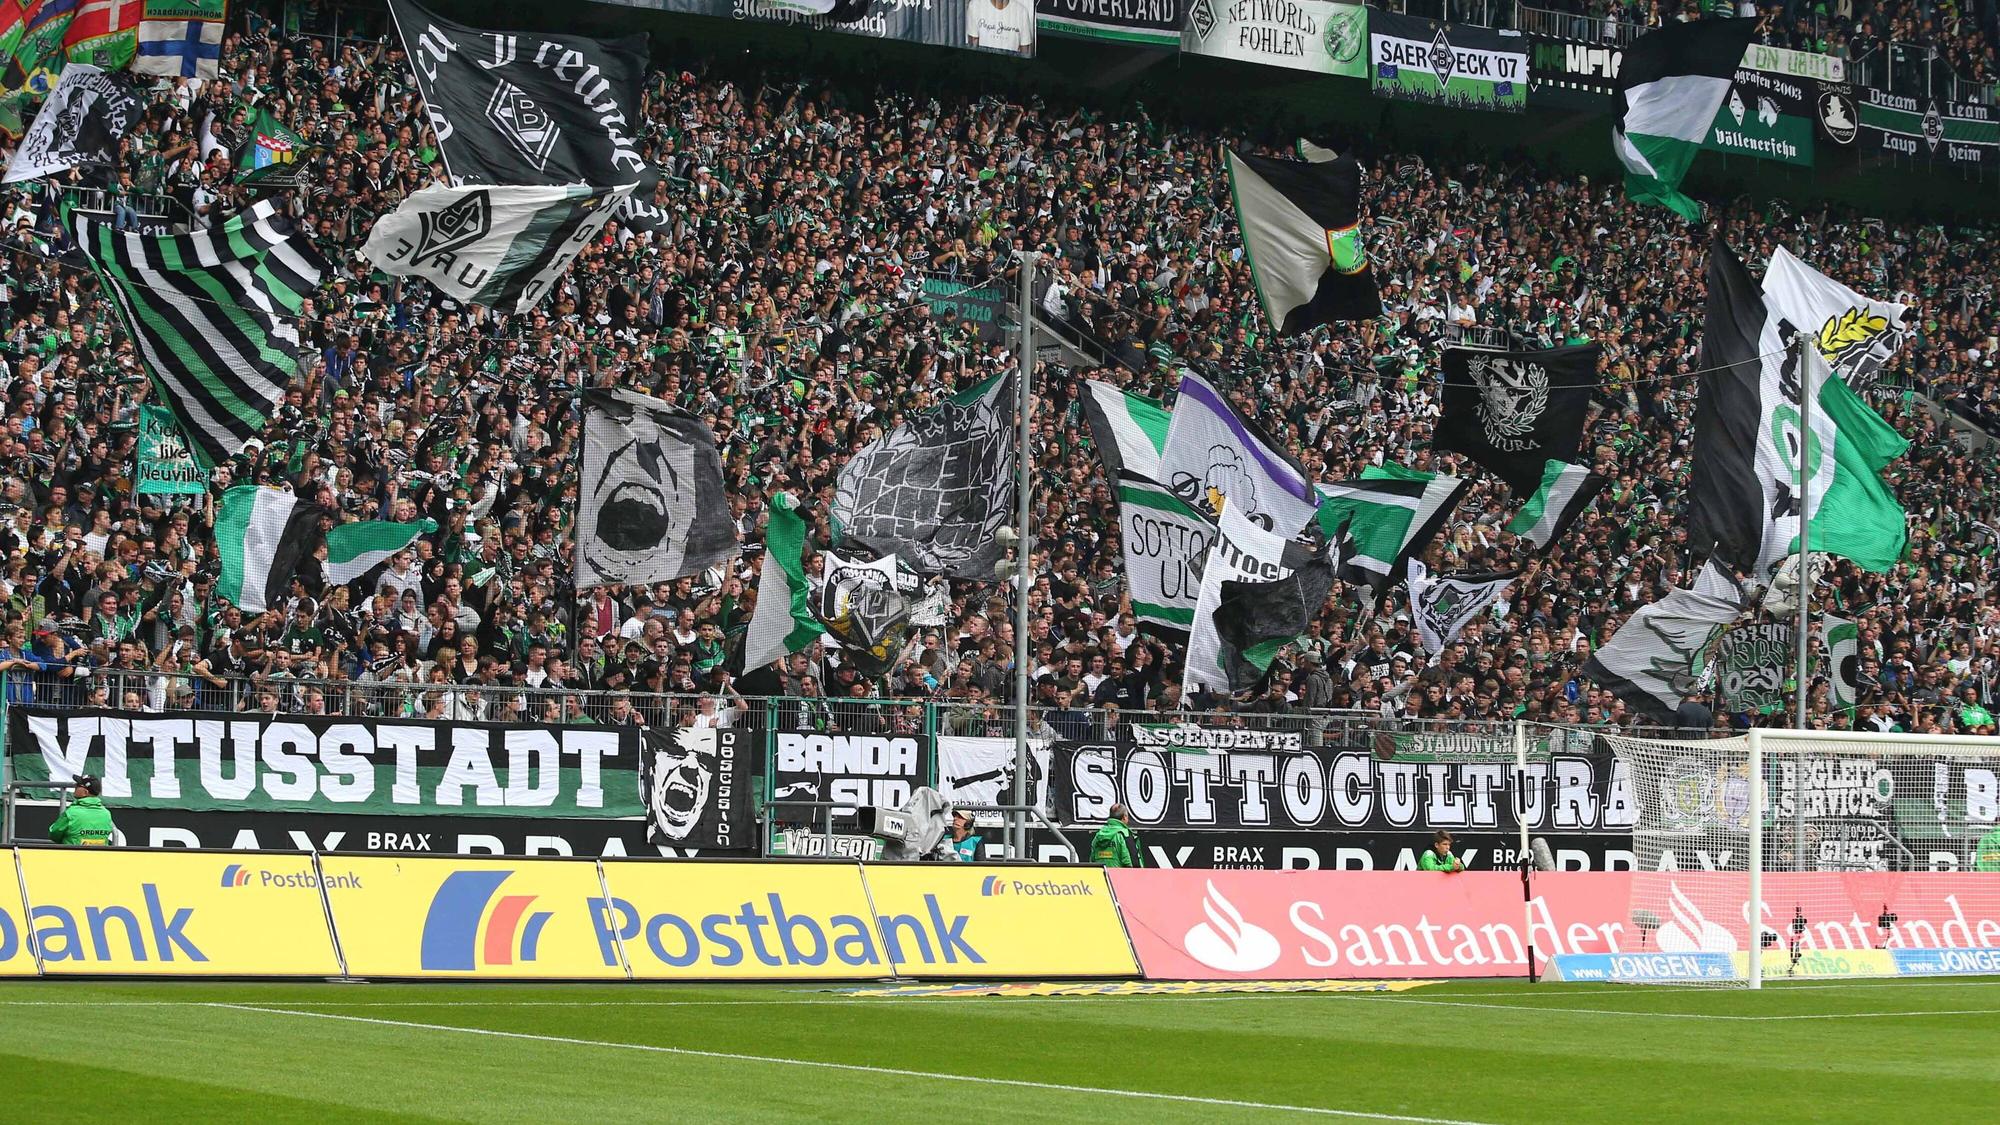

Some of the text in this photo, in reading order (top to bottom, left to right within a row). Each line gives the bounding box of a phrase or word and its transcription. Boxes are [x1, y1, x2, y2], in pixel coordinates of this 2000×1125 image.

[1055, 0, 1175, 23] OWERLAND
[1228, 0, 1317, 35] NETWORLD
[1239, 26, 1305, 57] FOHLEN
[1772, 78, 1803, 101] 2003
[1868, 87, 1918, 112] Dream
[1946, 100, 1989, 120] Team
[962, 302, 993, 322] 2010
[160, 443, 191, 459] like
[140, 463, 205, 483] Neuville
[1135, 724, 1302, 752] ASCENDENTE
[27, 715, 619, 808] VITUSSTADT
[777, 732, 919, 777] BANDA
[1071, 745, 1639, 830] SOTTOCULTURA
[366, 831, 432, 851] BRAX
[1213, 846, 1265, 863] BRAX
[260, 869, 363, 890] Postbank
[1012, 879, 1094, 897] Postbank
[586, 892, 988, 968] Postbank
[1289, 895, 1625, 969] Santander
[1608, 954, 1701, 979] JONGEN
